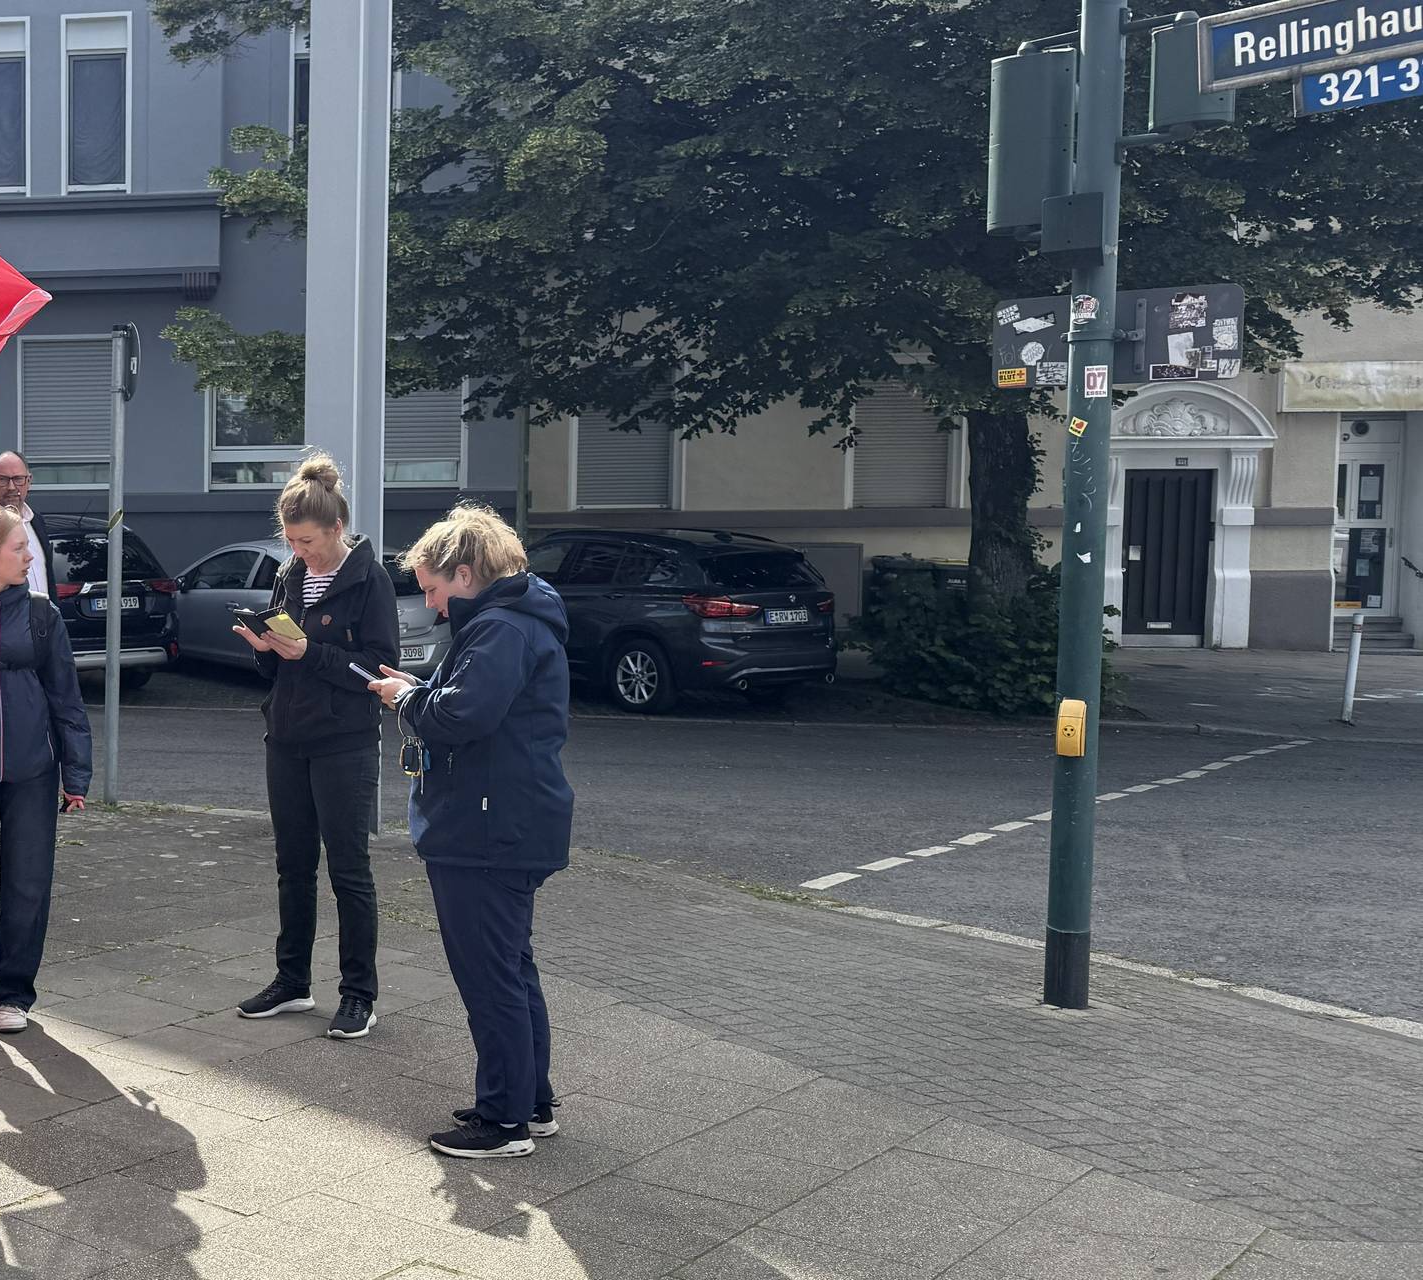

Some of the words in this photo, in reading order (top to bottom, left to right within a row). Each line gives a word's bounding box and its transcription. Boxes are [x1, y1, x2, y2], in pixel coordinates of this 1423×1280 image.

[1233, 5, 1423, 67] Rellinghau
[1318, 57, 1423, 107] 321-3
[1086, 372, 1107, 391] 07
[403, 648, 423, 658] 3098
